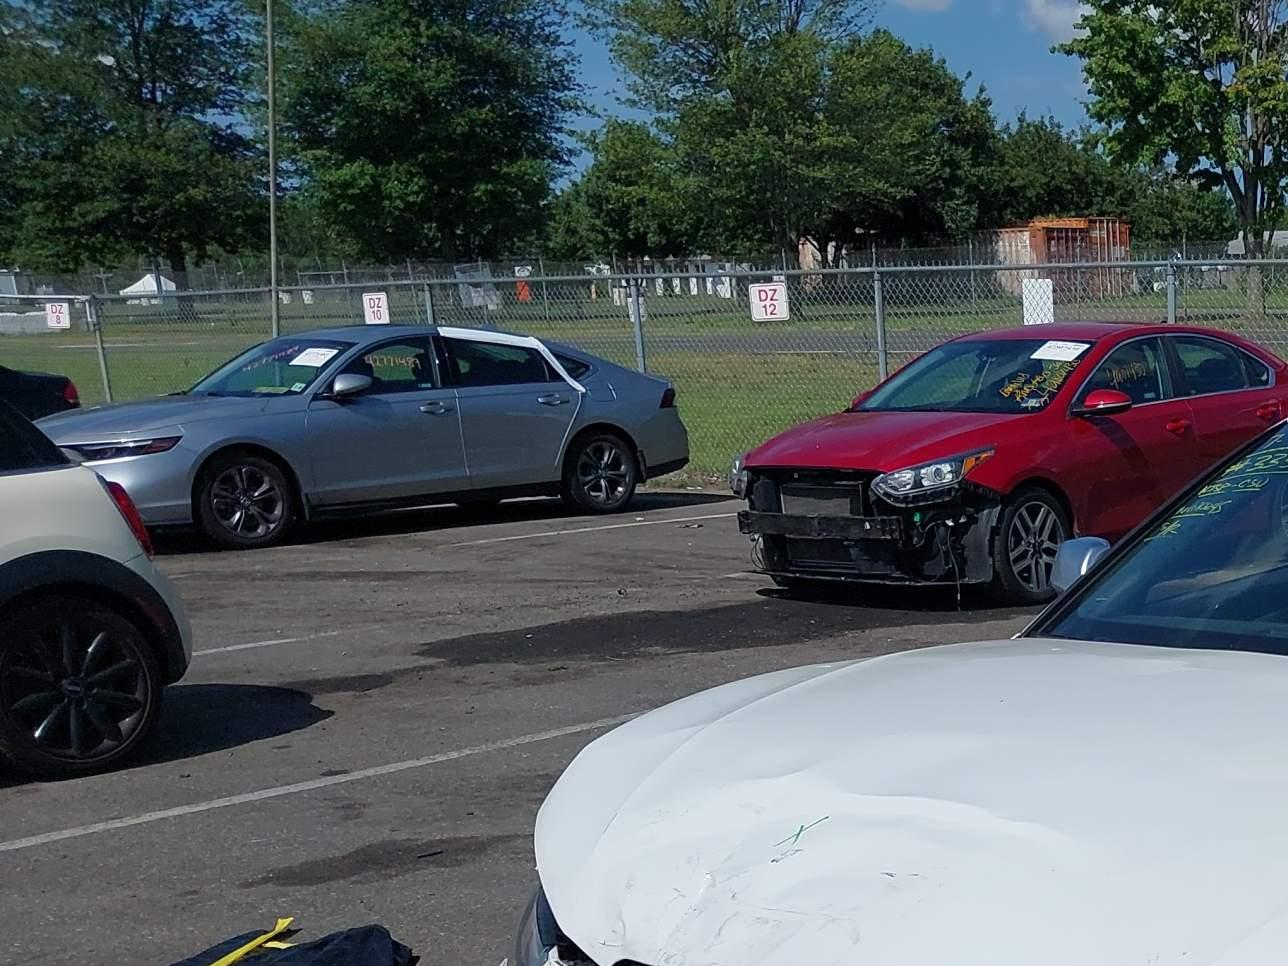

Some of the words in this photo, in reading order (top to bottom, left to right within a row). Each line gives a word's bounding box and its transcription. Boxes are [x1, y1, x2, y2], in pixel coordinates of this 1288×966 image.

[758, 289, 779, 302] DZ
[51, 304, 64, 314] DZ
[369, 297, 382, 309] DZ
[371, 309, 382, 320] 10
[762, 303, 777, 316] 12
